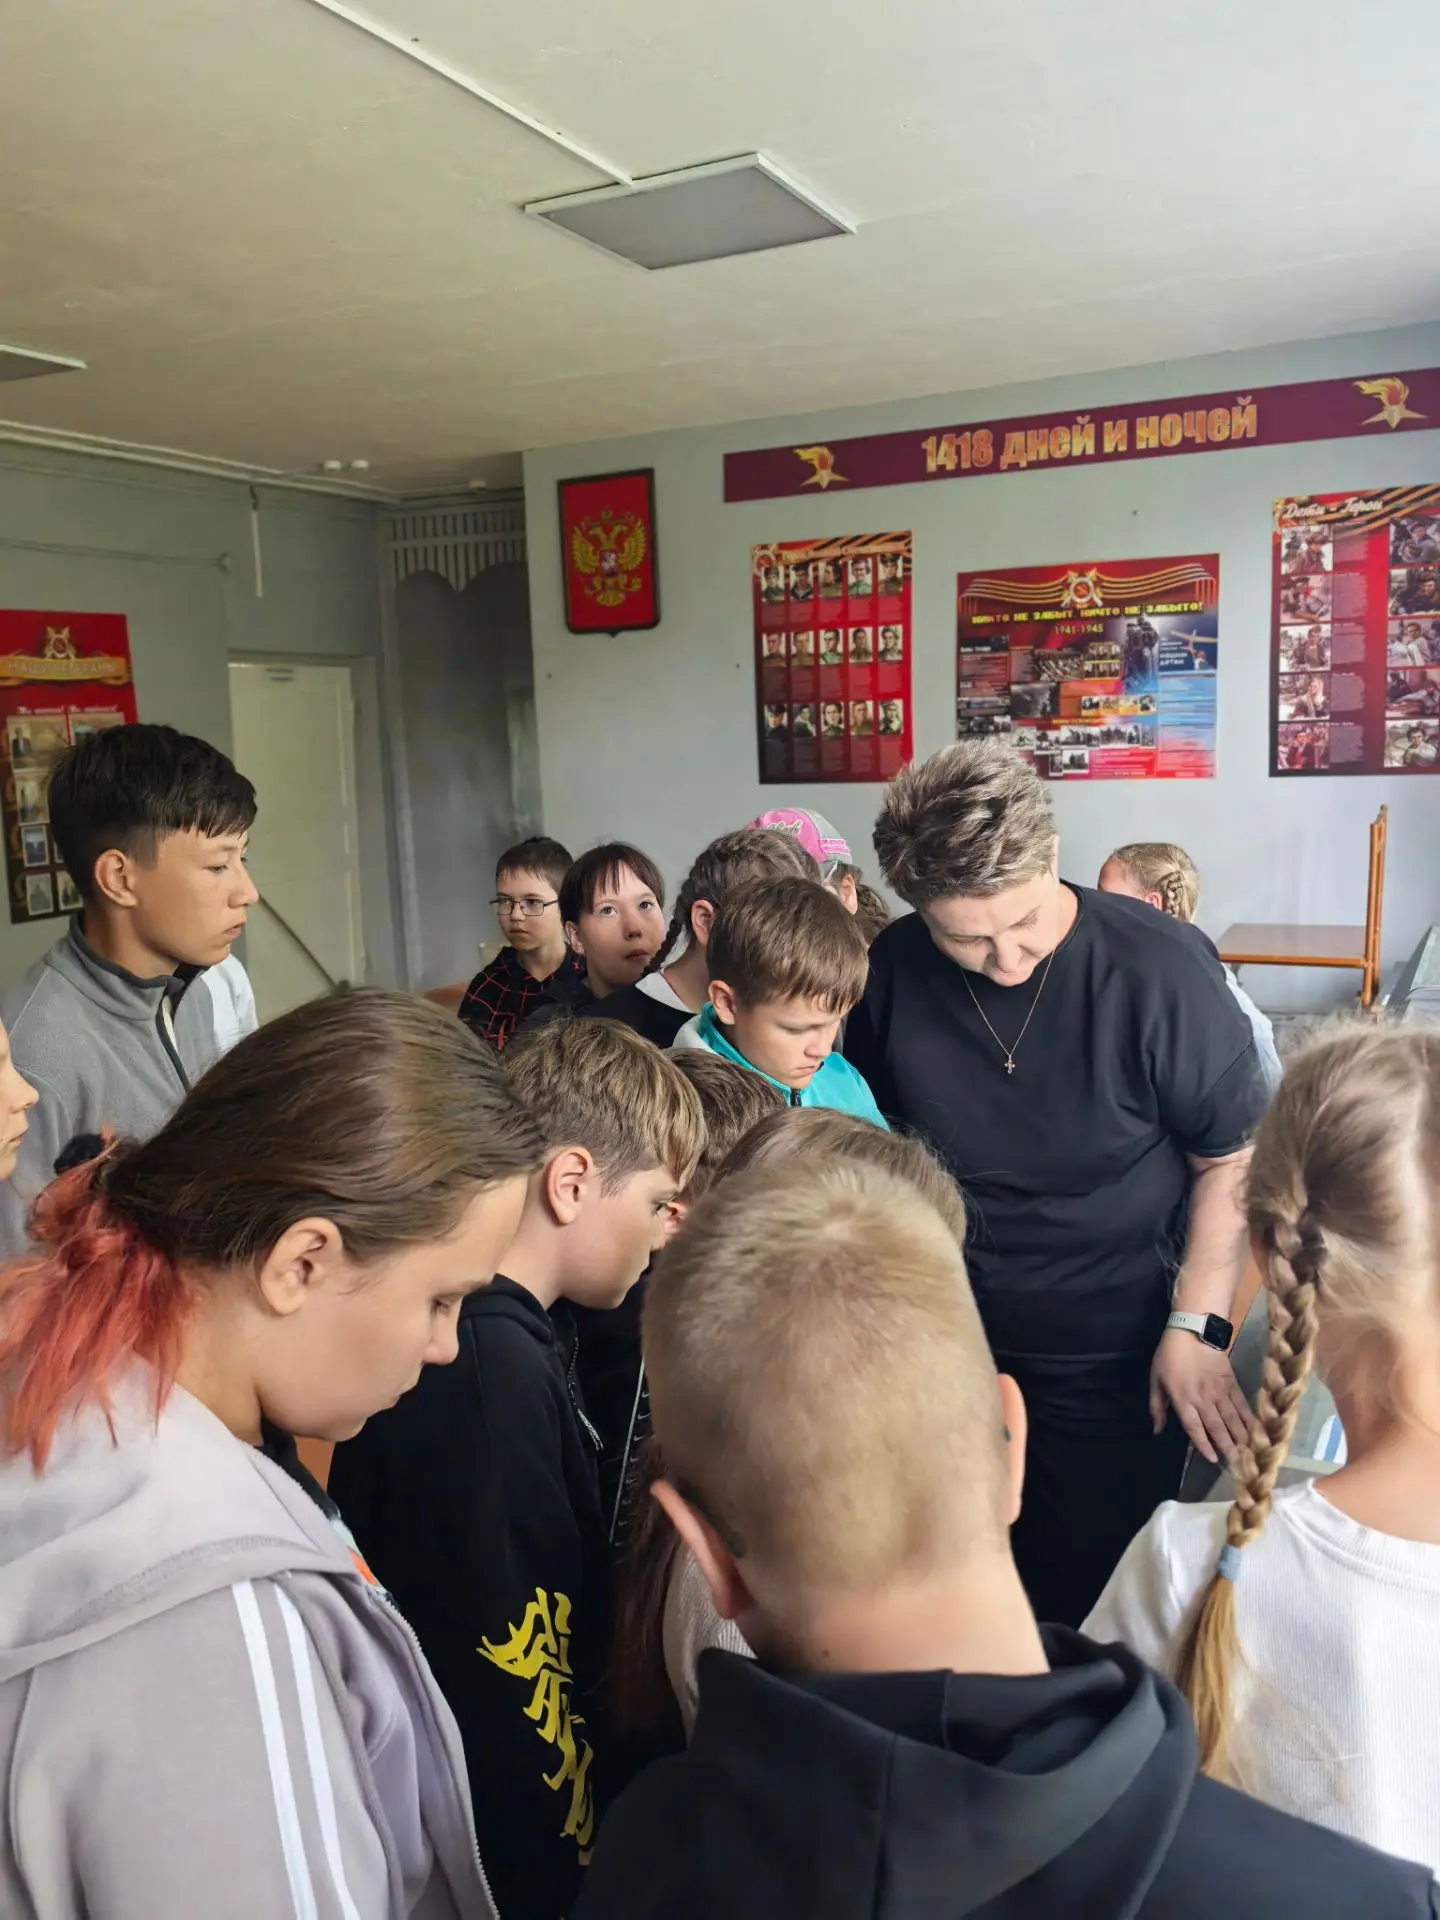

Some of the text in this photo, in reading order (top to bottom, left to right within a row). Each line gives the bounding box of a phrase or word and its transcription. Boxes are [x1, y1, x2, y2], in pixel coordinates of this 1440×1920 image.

[921, 429, 994, 473] 1418
[1000, 415, 1096, 470] дней
[1135, 396, 1258, 449] ночей
[972, 613, 1010, 624] НИКТО
[1013, 611, 1029, 621] НЕ
[1124, 605, 1141, 615] НЕ
